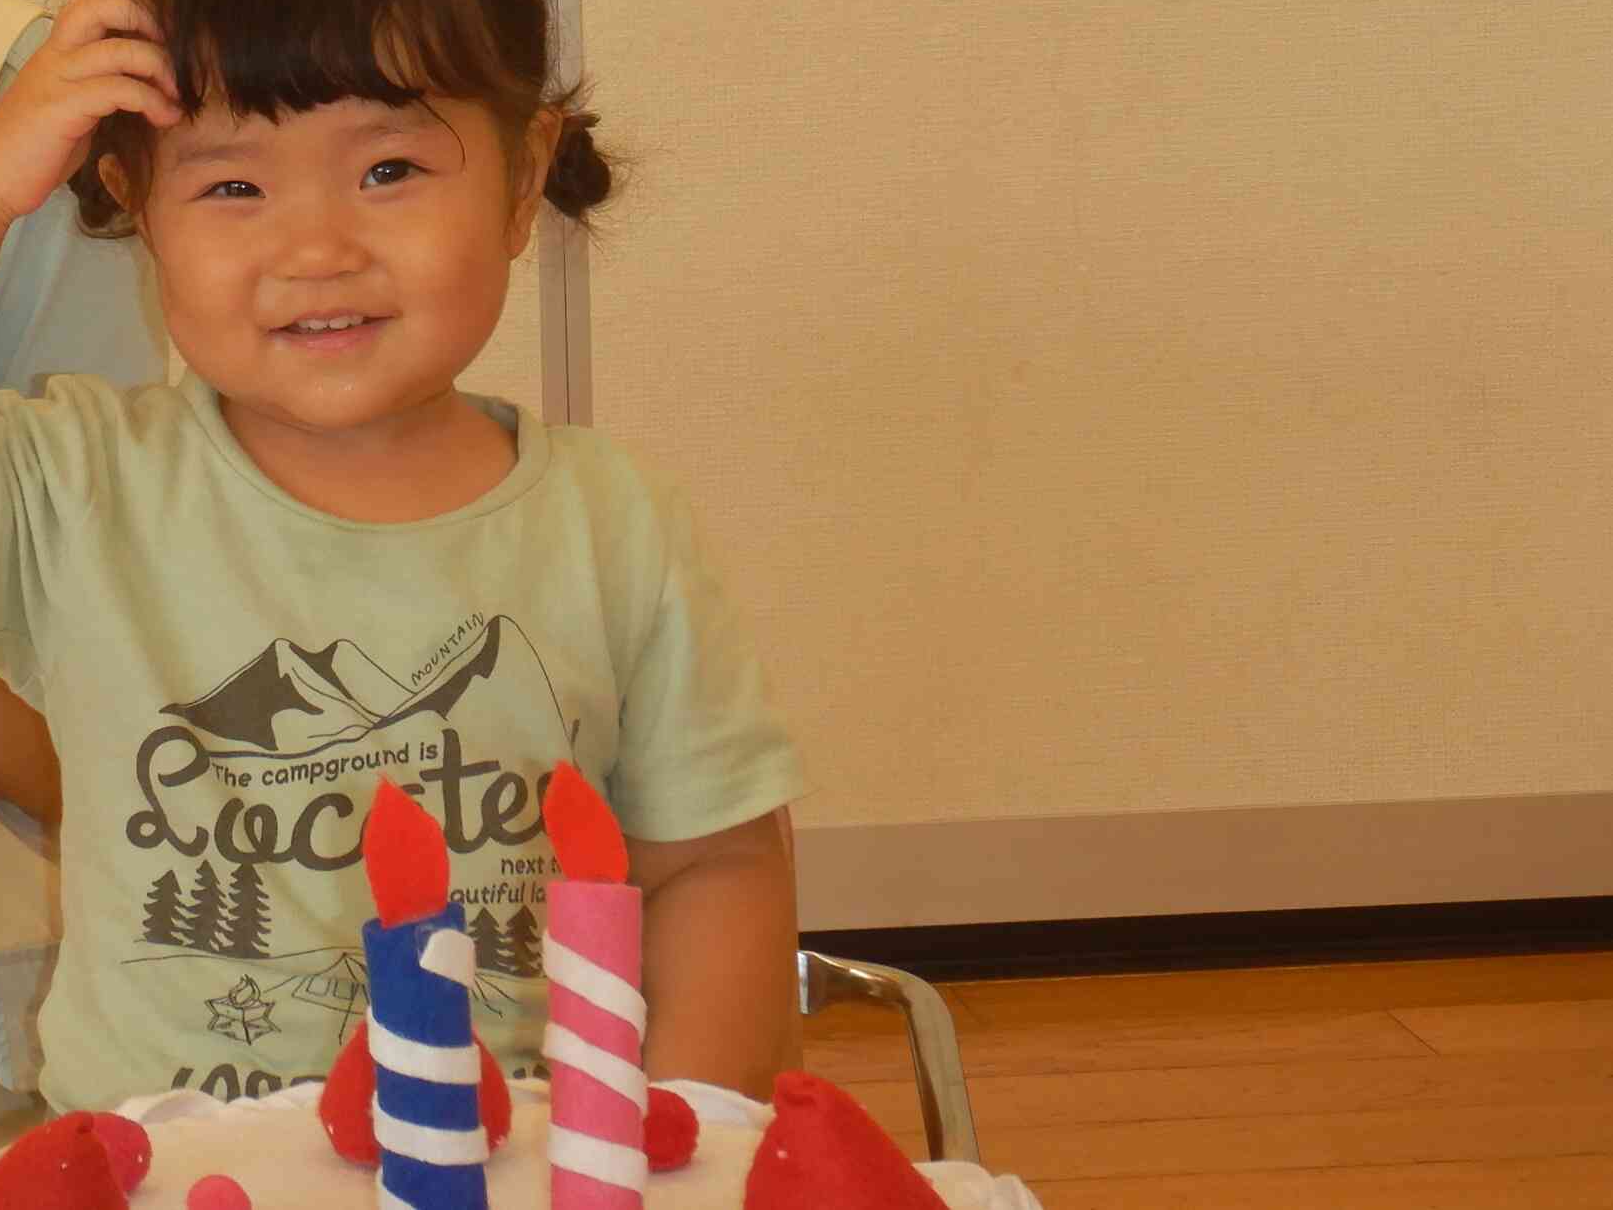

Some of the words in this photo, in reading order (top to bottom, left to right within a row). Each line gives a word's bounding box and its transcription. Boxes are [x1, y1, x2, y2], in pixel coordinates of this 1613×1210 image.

[410, 611, 484, 687] MOUNTAIN
[212, 762, 253, 788] The
[261, 742, 410, 786] campground
[419, 741, 439, 761] is
[125, 719, 581, 872] Locte
[500, 855, 544, 875] next
[449, 881, 526, 905] autiful
